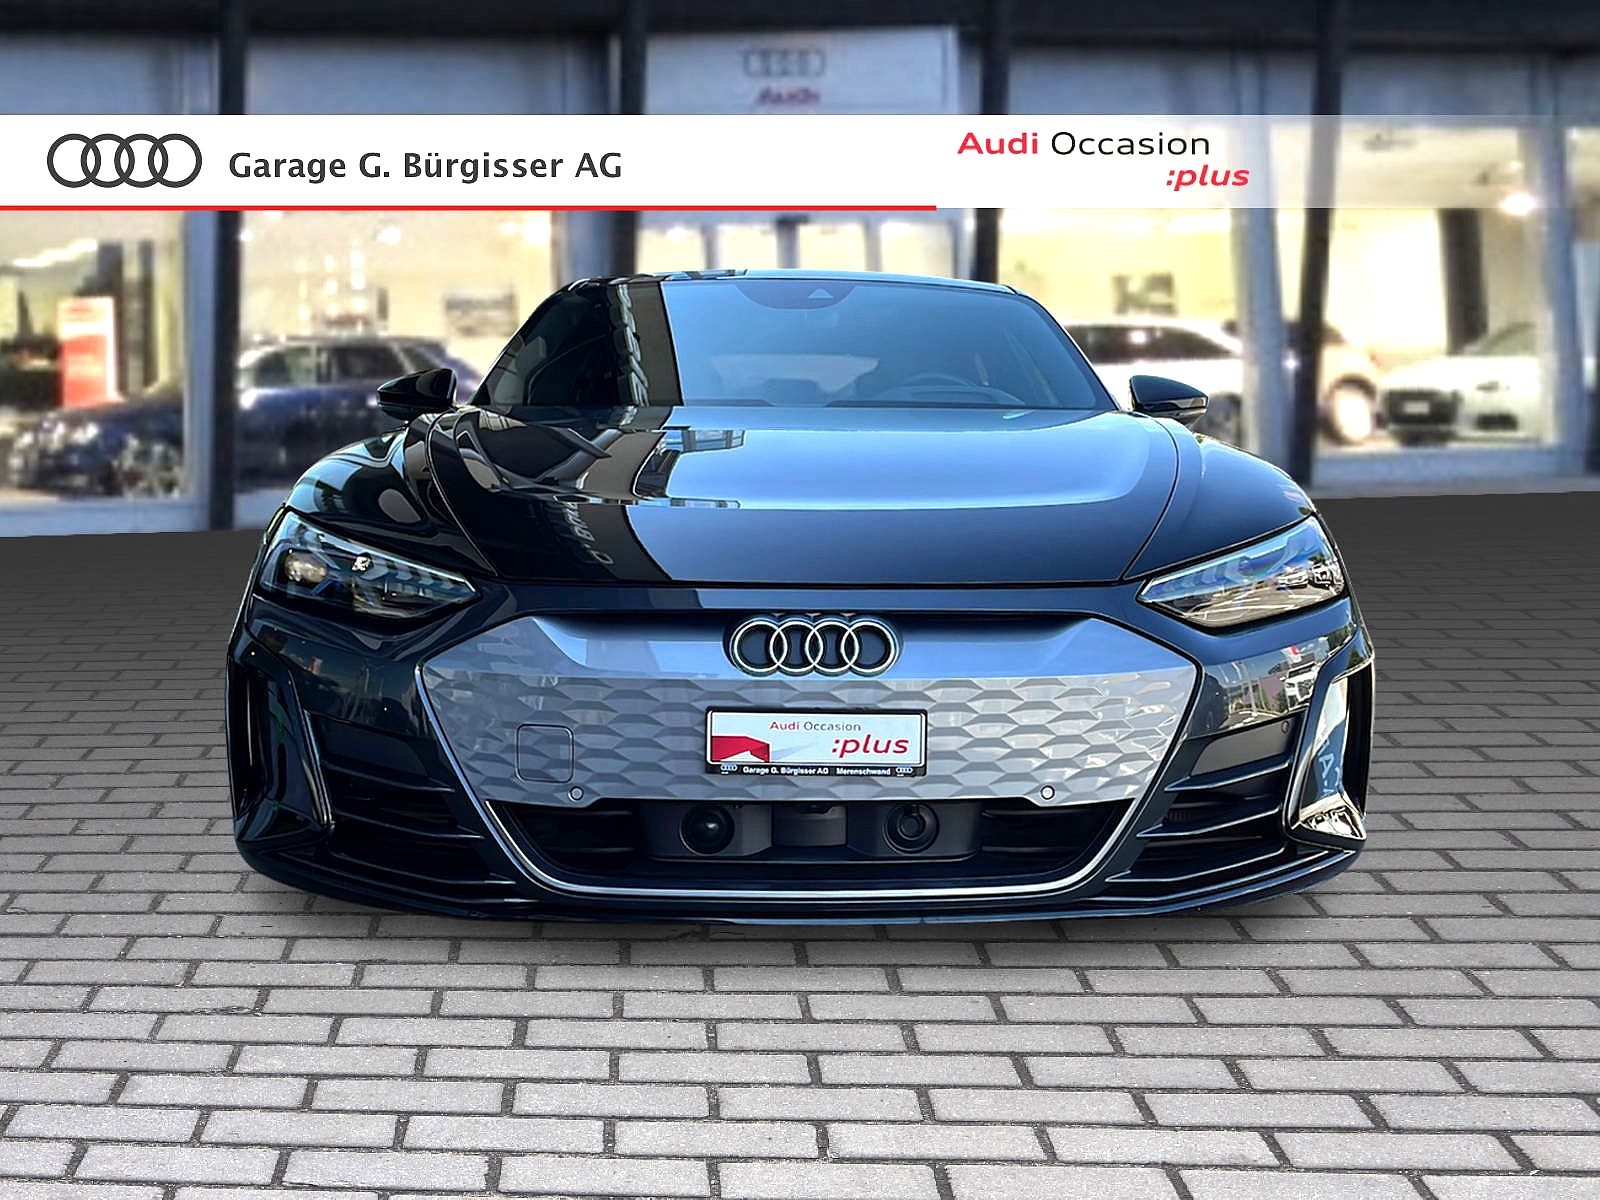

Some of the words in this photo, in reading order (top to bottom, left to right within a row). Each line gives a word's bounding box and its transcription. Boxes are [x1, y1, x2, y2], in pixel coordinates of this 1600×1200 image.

[769, 721, 800, 731] Audi
[803, 721, 862, 732] Occasion
[832, 733, 910, 759] :plus
[743, 766, 769, 775] Garage
[780, 766, 816, 776] Bürgisser
[816, 767, 829, 775] AG
